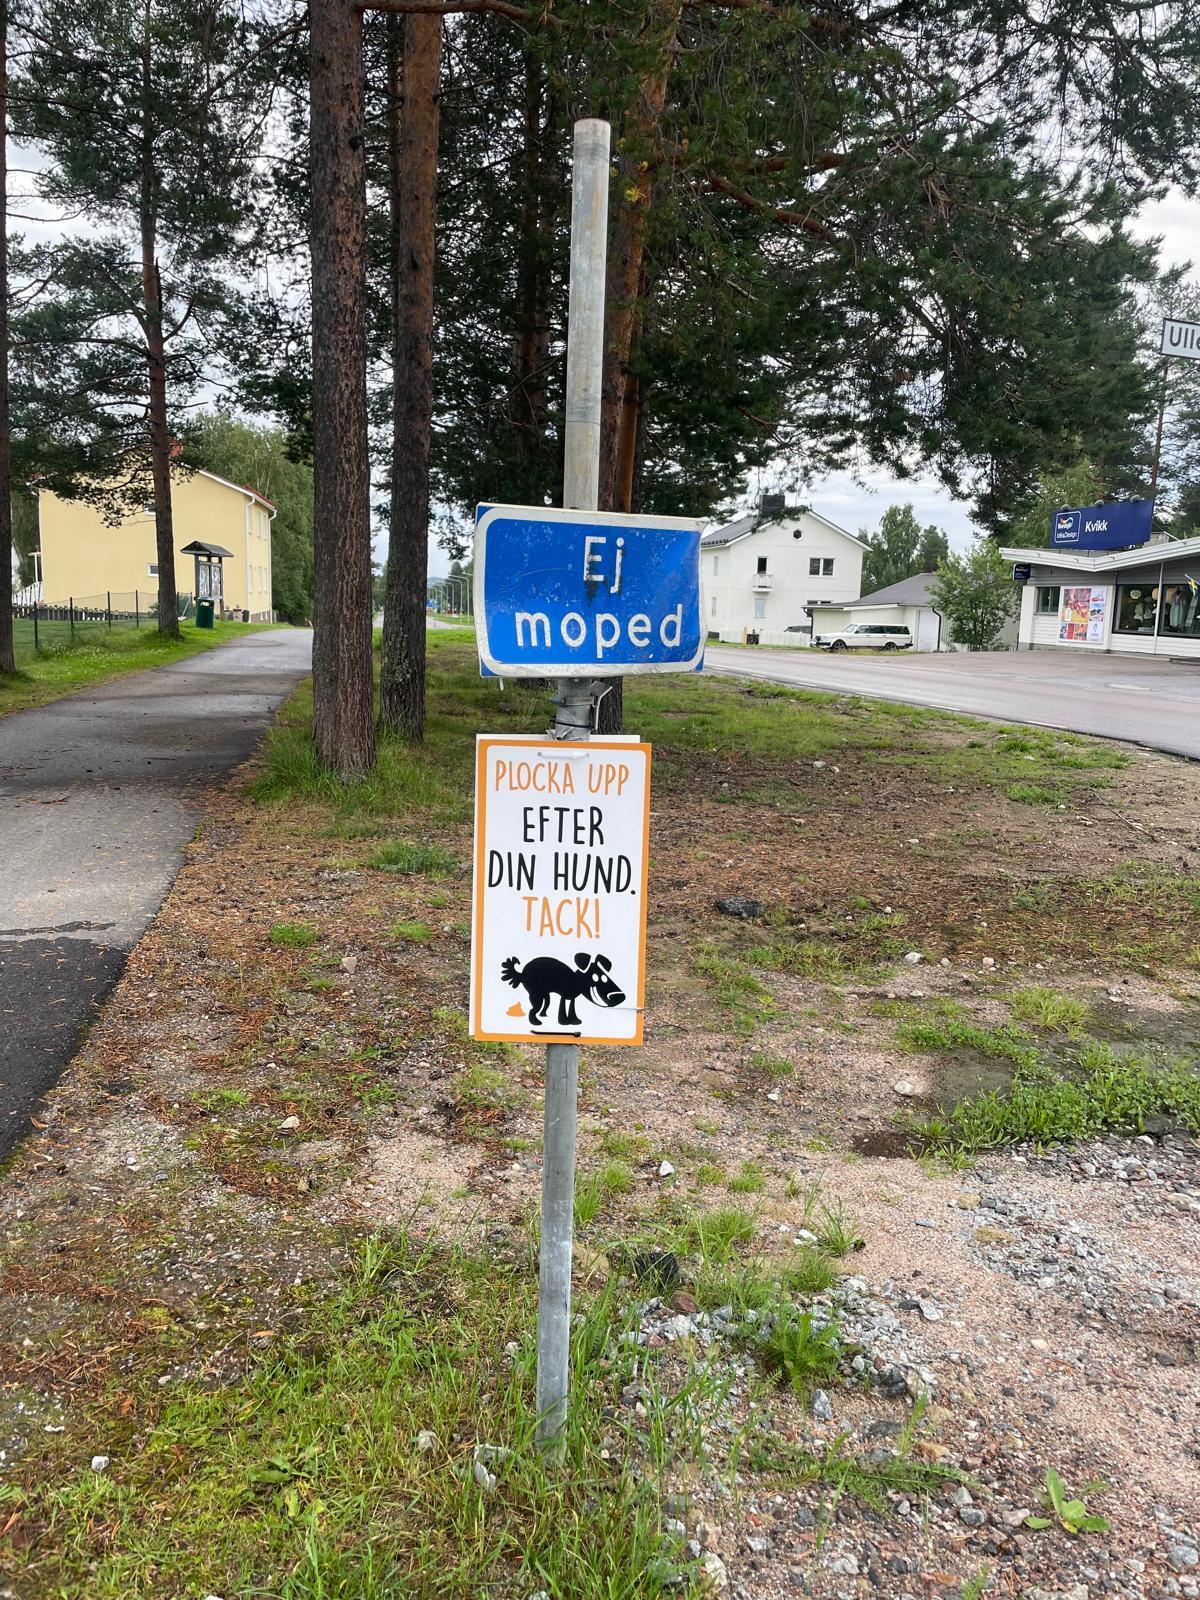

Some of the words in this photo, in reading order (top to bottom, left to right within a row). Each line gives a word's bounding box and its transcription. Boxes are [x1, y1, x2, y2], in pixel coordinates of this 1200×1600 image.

[1085, 519, 1108, 532] Kvikk
[584, 536, 625, 594] Ej
[515, 603, 683, 659] moped
[495, 759, 575, 794] PLOCKA
[588, 763, 630, 796] UPP
[522, 805, 605, 847] EFTER
[488, 849, 536, 891] DIN
[553, 852, 636, 895] HUND.
[522, 896, 601, 939] TACK!
